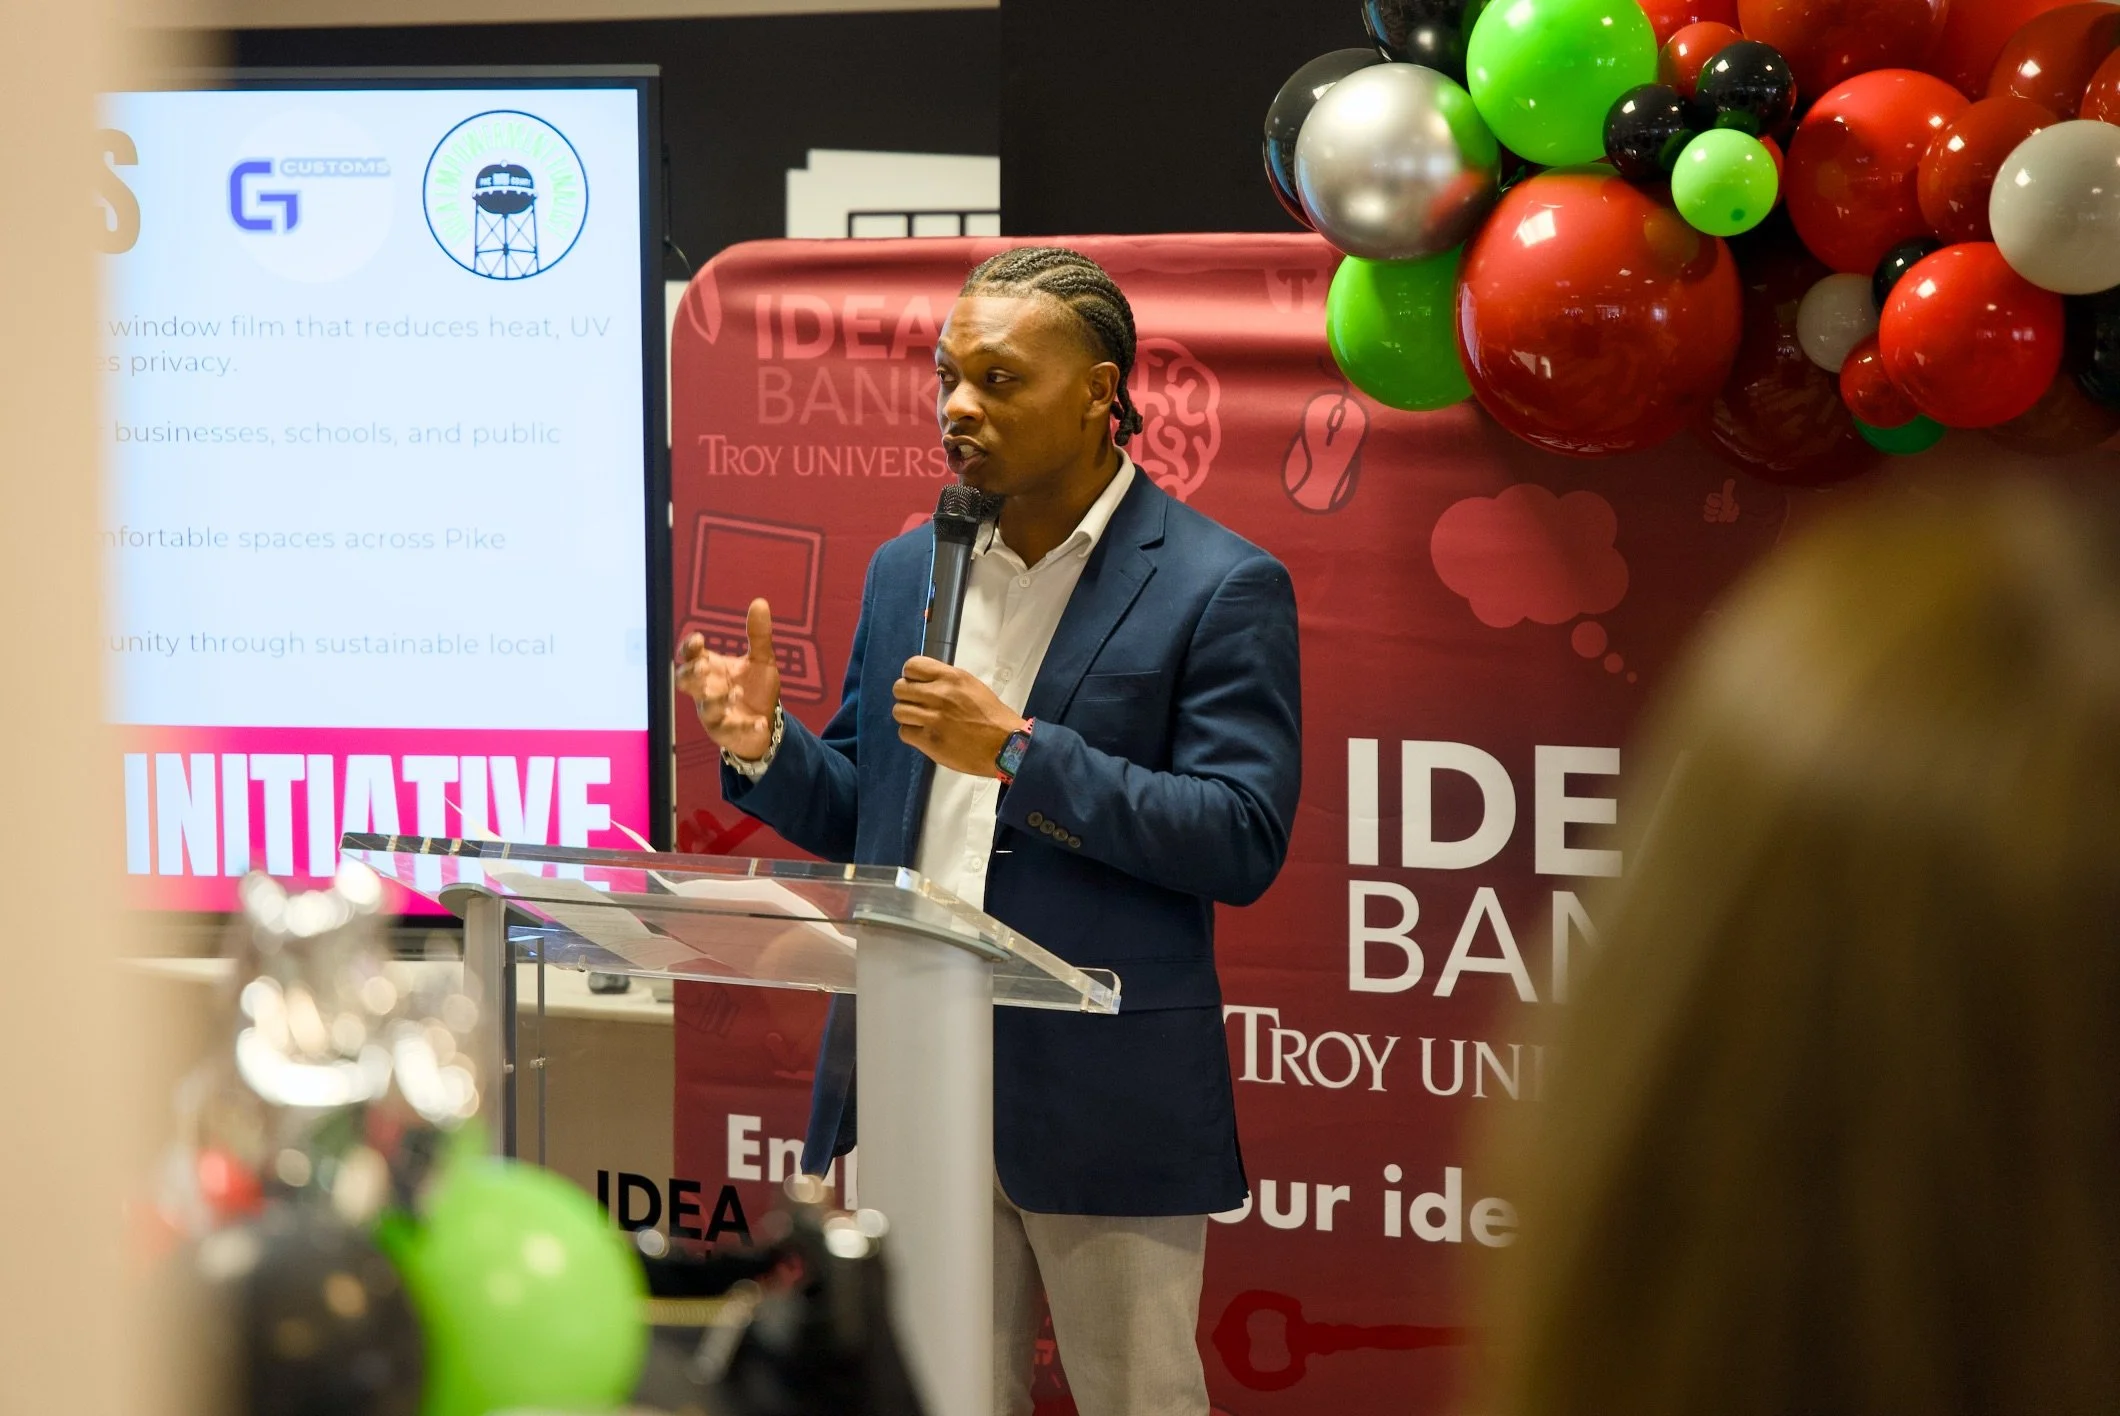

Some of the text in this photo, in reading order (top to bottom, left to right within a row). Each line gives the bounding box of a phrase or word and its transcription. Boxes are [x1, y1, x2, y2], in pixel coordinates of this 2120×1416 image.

[282, 158, 391, 175] CUSTOMS
[108, 314, 221, 338] window
[231, 314, 286, 338] film
[295, 314, 355, 338] that
[365, 314, 480, 338] reduces
[489, 314, 560, 341] heat,
[570, 316, 611, 338] UV
[755, 294, 943, 360] IDEA
[130, 350, 238, 377] privacy.
[757, 366, 940, 426] BANK
[114, 420, 276, 447] businesses,
[284, 420, 398, 447] schools,
[407, 421, 462, 445] and
[472, 421, 561, 449] public
[237, 531, 336, 554] spaces
[344, 532, 436, 550] across
[445, 527, 507, 550] Pike
[189, 630, 305, 660] through
[314, 631, 480, 656] sustainable
[489, 632, 556, 656] local
[123, 752, 612, 892] INITIATIVE
[597, 1169, 755, 1246] IDEA
